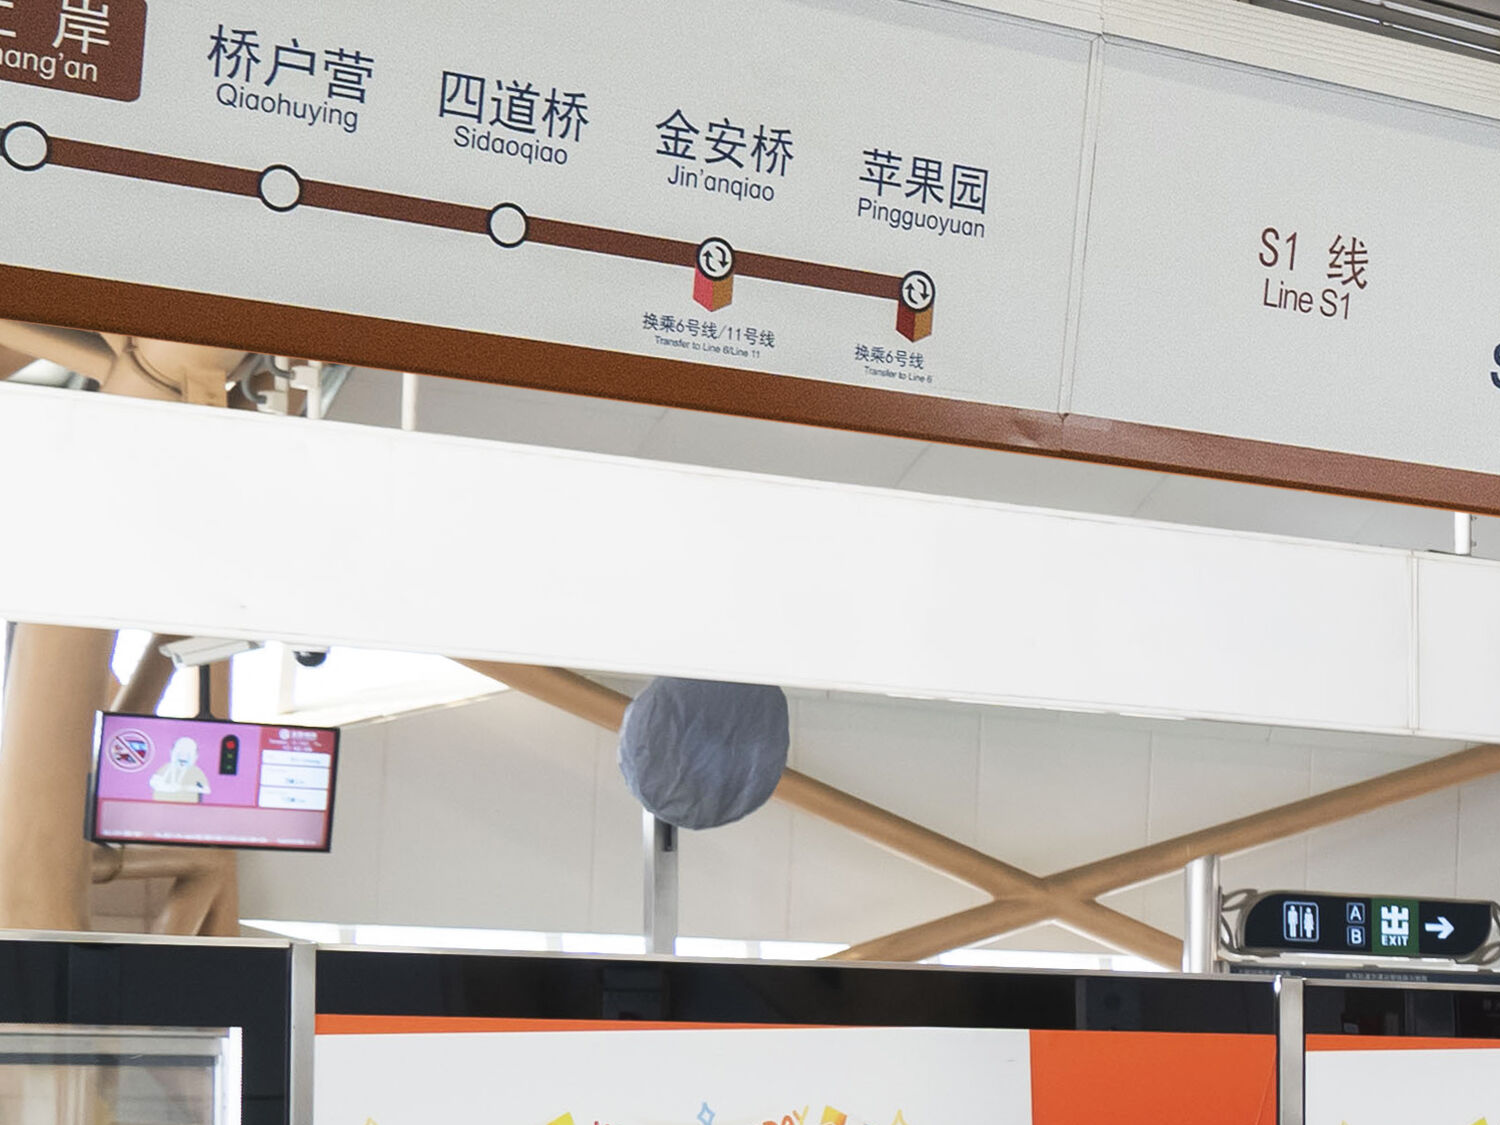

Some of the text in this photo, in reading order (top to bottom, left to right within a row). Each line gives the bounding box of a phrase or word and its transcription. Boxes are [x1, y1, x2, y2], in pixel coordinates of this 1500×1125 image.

[207, 24, 374, 103] 桥户营
[215, 83, 359, 133] Qiaohuying
[439, 70, 590, 142] 四道桥
[453, 126, 569, 166] Sidaoqiao
[656, 108, 795, 177] 金安桥
[668, 166, 775, 201] Jin'anqiao
[859, 148, 990, 215] 苹果园
[857, 198, 986, 239] Pingguoyuan
[1263, 278, 1351, 321] Line S1
[642, 312, 776, 348] 换乘6号线/11号线
[655, 335, 690, 350] Transfer
[691, 341, 701, 350] to
[703, 342, 721, 354] Line
[854, 343, 924, 370] 换乘6号线
[908, 372, 925, 383] Line
[1350, 905, 1362, 921] A
[1351, 929, 1362, 944] B
[1381, 934, 1408, 947] EXIT
